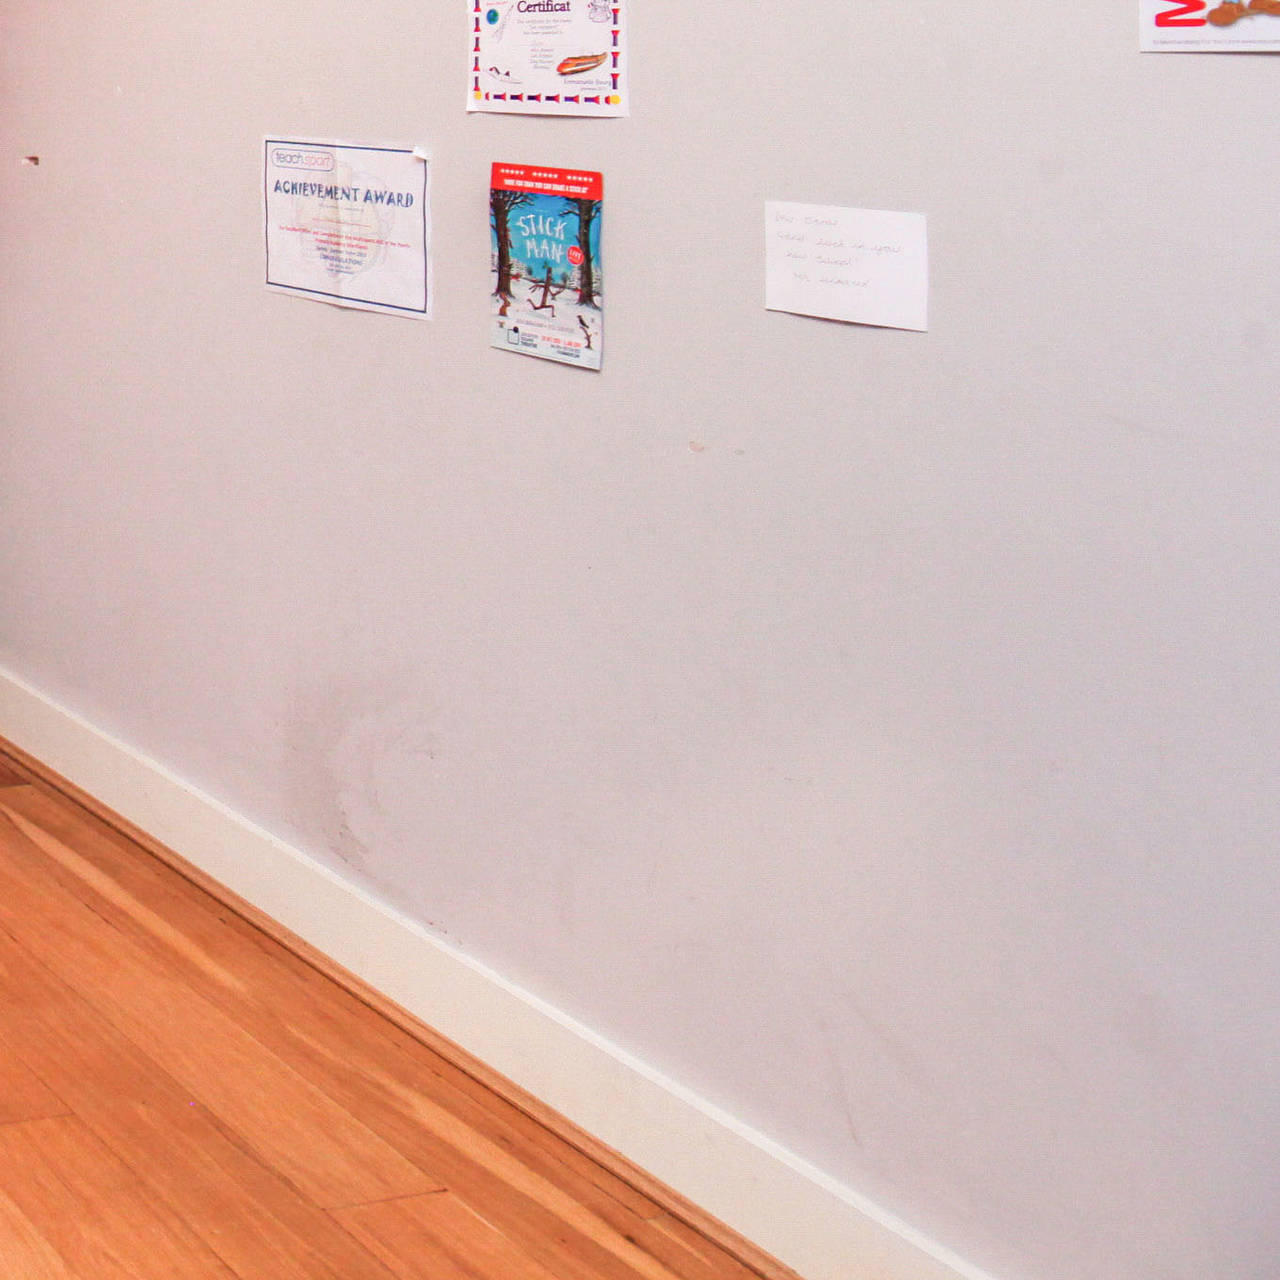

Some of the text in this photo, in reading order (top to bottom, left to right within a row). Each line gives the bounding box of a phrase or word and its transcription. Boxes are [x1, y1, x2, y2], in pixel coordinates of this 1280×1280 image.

[517, 0, 571, 13] Certificat
[274, 179, 359, 202] ACHIEVEMENT
[363, 189, 414, 208] AWARD
[516, 214, 567, 240] STICK
[526, 238, 564, 263] MAN
